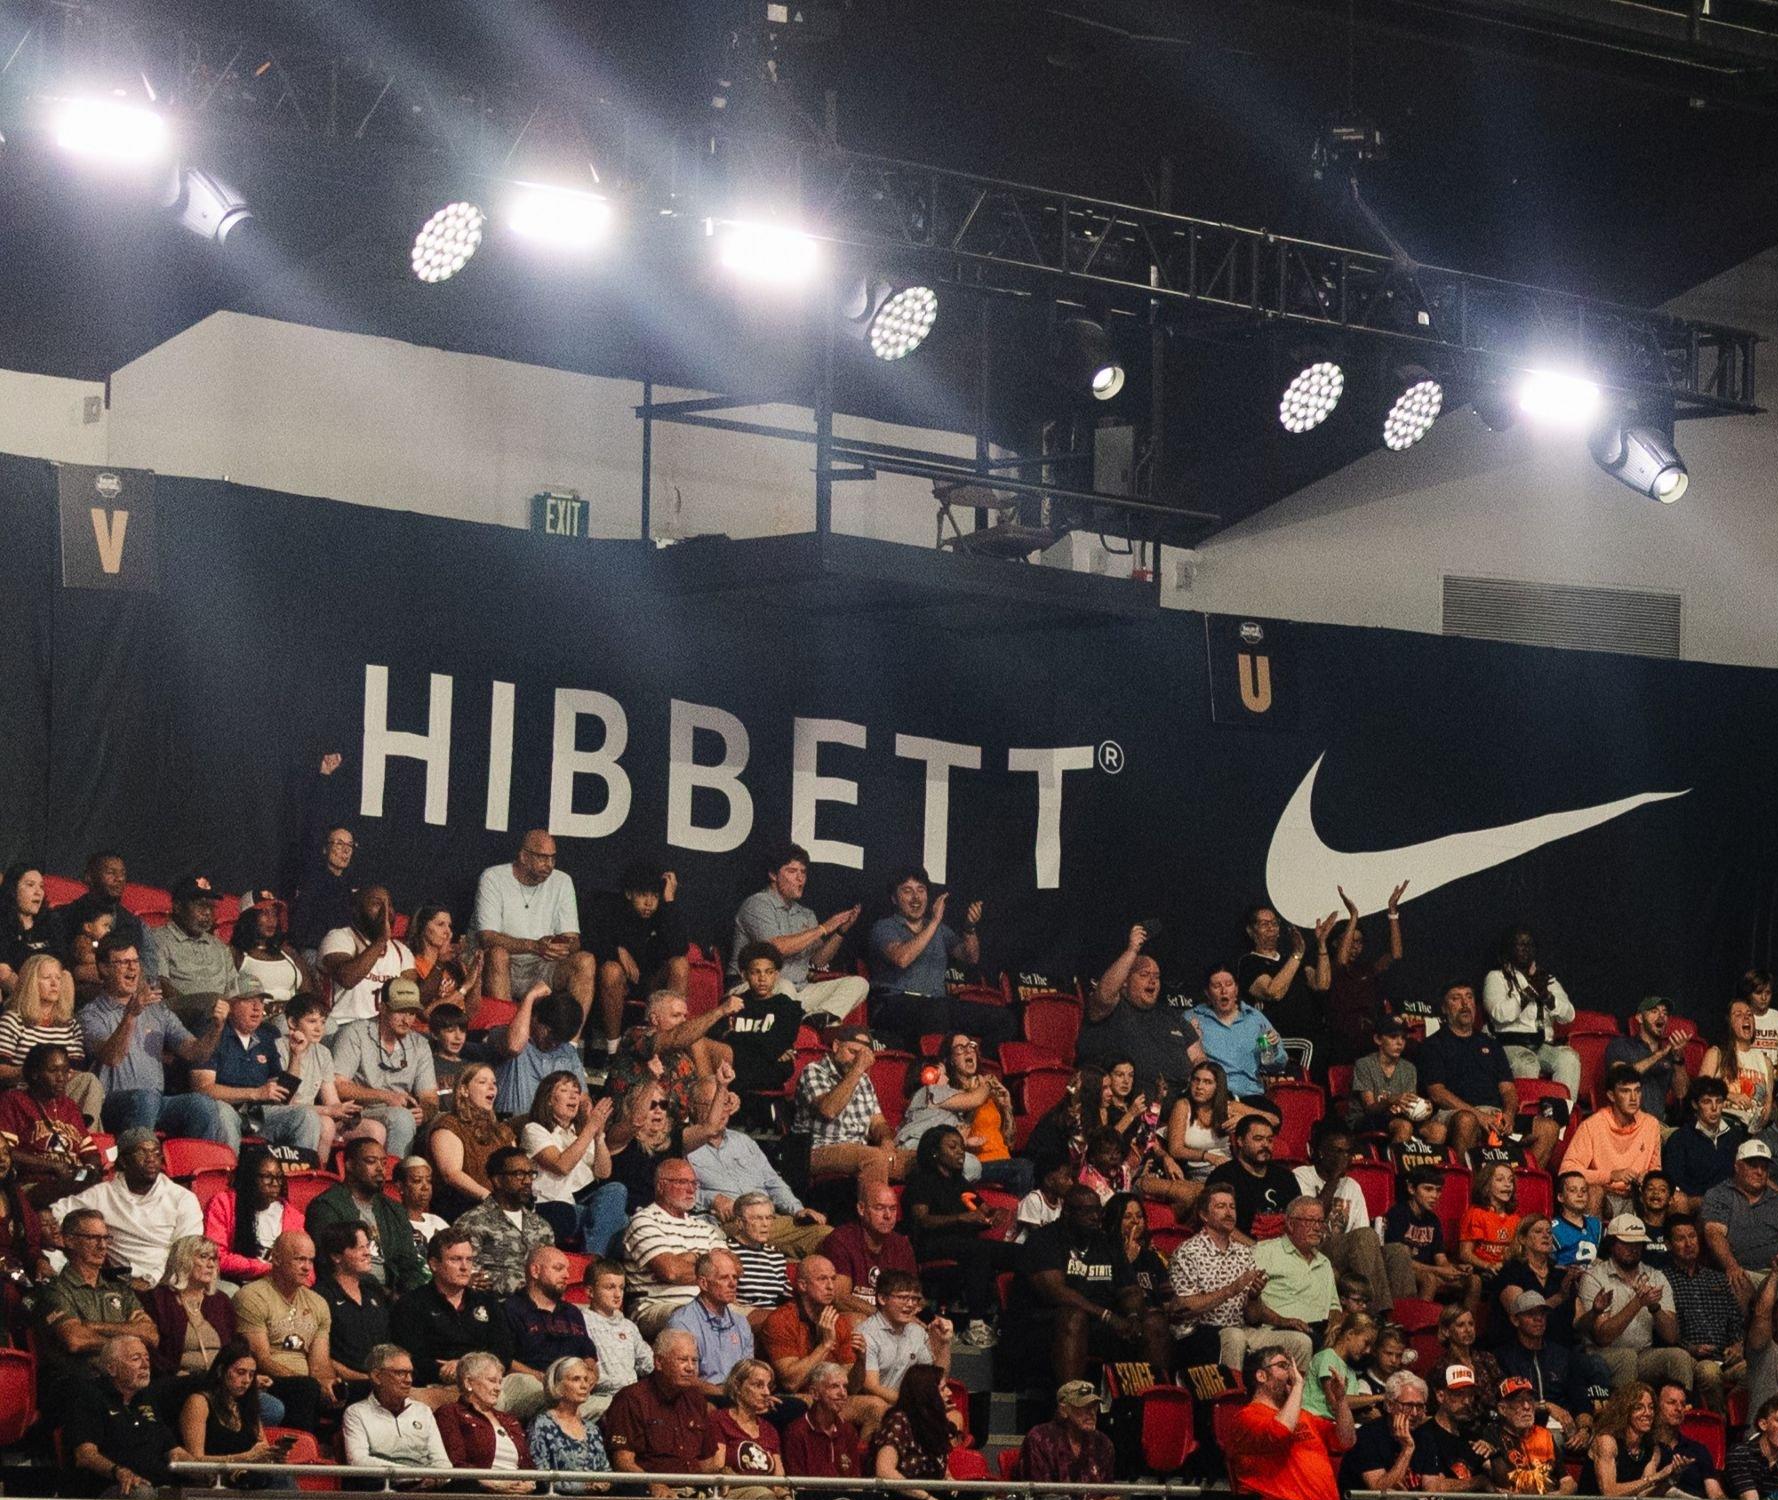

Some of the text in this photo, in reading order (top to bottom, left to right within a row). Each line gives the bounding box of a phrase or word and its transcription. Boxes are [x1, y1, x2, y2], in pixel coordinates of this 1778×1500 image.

[91, 508, 130, 574] V
[546, 499, 581, 537] EXIT
[1238, 653, 1272, 713] U
